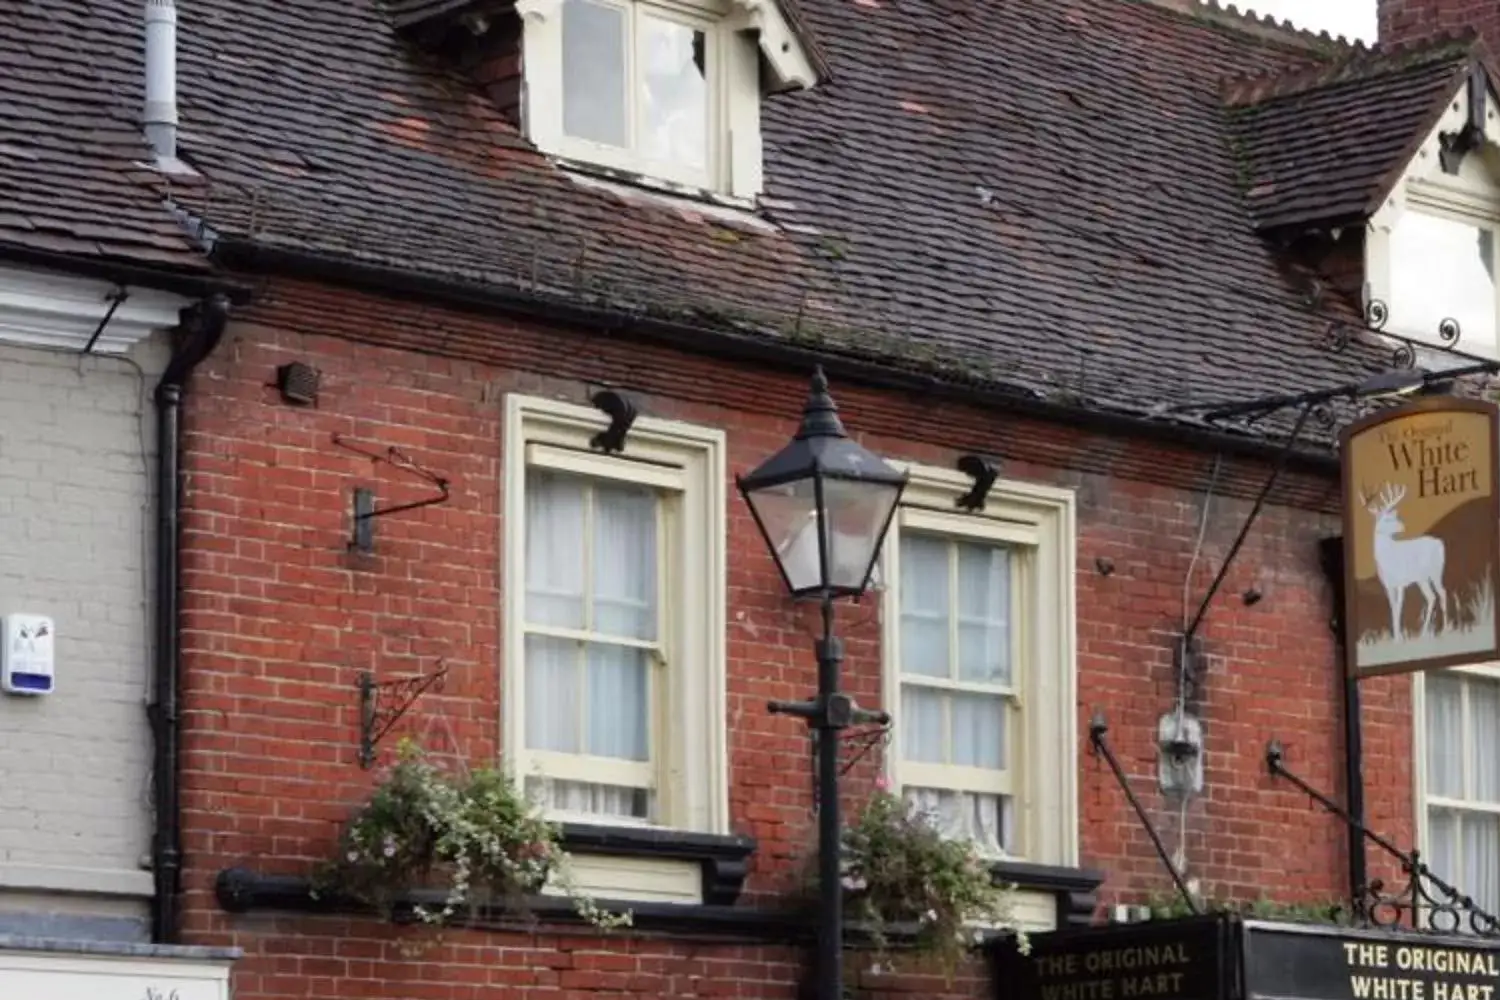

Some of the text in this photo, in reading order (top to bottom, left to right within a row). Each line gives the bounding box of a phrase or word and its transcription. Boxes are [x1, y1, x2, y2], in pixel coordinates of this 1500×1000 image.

[1387, 435, 1469, 471] White
[1418, 466, 1480, 498] Hart
[1034, 943, 1191, 977] THE ORIGINAL
[1343, 941, 1500, 977] THE ORIGINAL
[1122, 972, 1185, 998] HART
